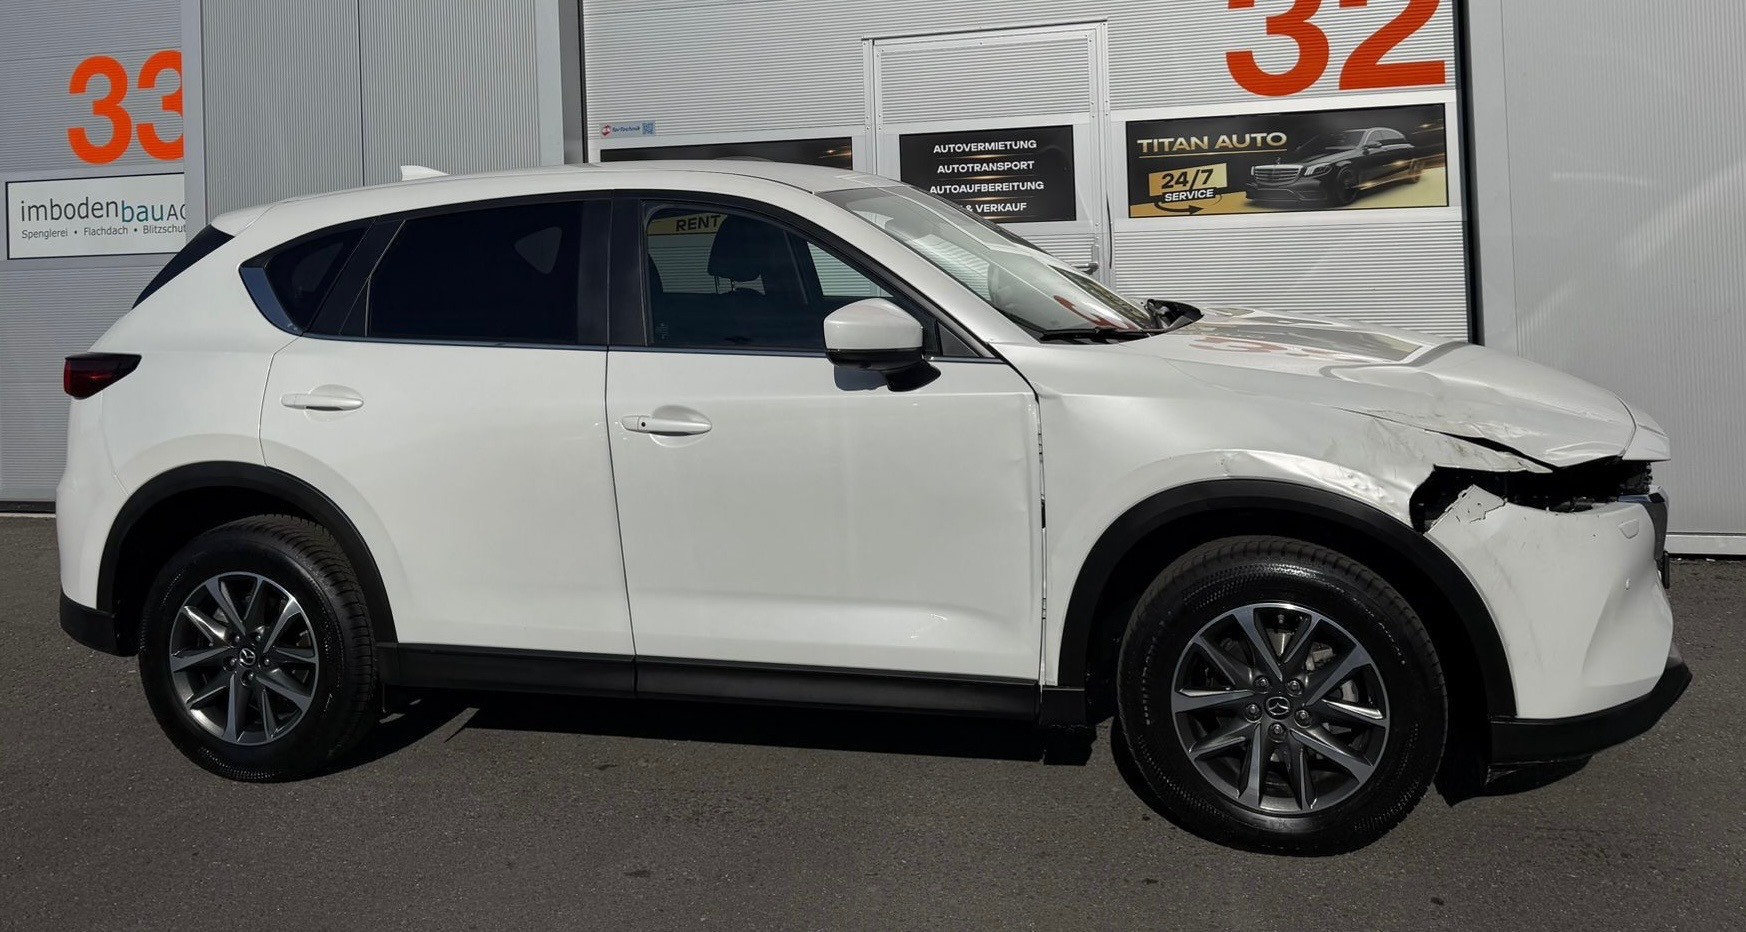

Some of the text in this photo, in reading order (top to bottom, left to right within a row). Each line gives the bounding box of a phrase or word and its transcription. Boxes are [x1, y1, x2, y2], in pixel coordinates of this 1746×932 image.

[1226, 0, 1446, 96] 32
[67, 50, 184, 165] 33
[933, 140, 1037, 153] AUTOVERMIETUNG
[1137, 132, 1287, 153] TITAN AUTO
[937, 160, 1035, 174] AUTOTRANSPORT
[930, 181, 1045, 194] AUTOAUFBEREITUNG
[1162, 168, 1214, 192] 24/7
[1164, 188, 1214, 202] SERVICE
[975, 202, 1027, 213] VERKAUF
[675, 214, 721, 232] RENT
[21, 228, 68, 240] Spenglerei
[83, 225, 128, 236] Flachdach
